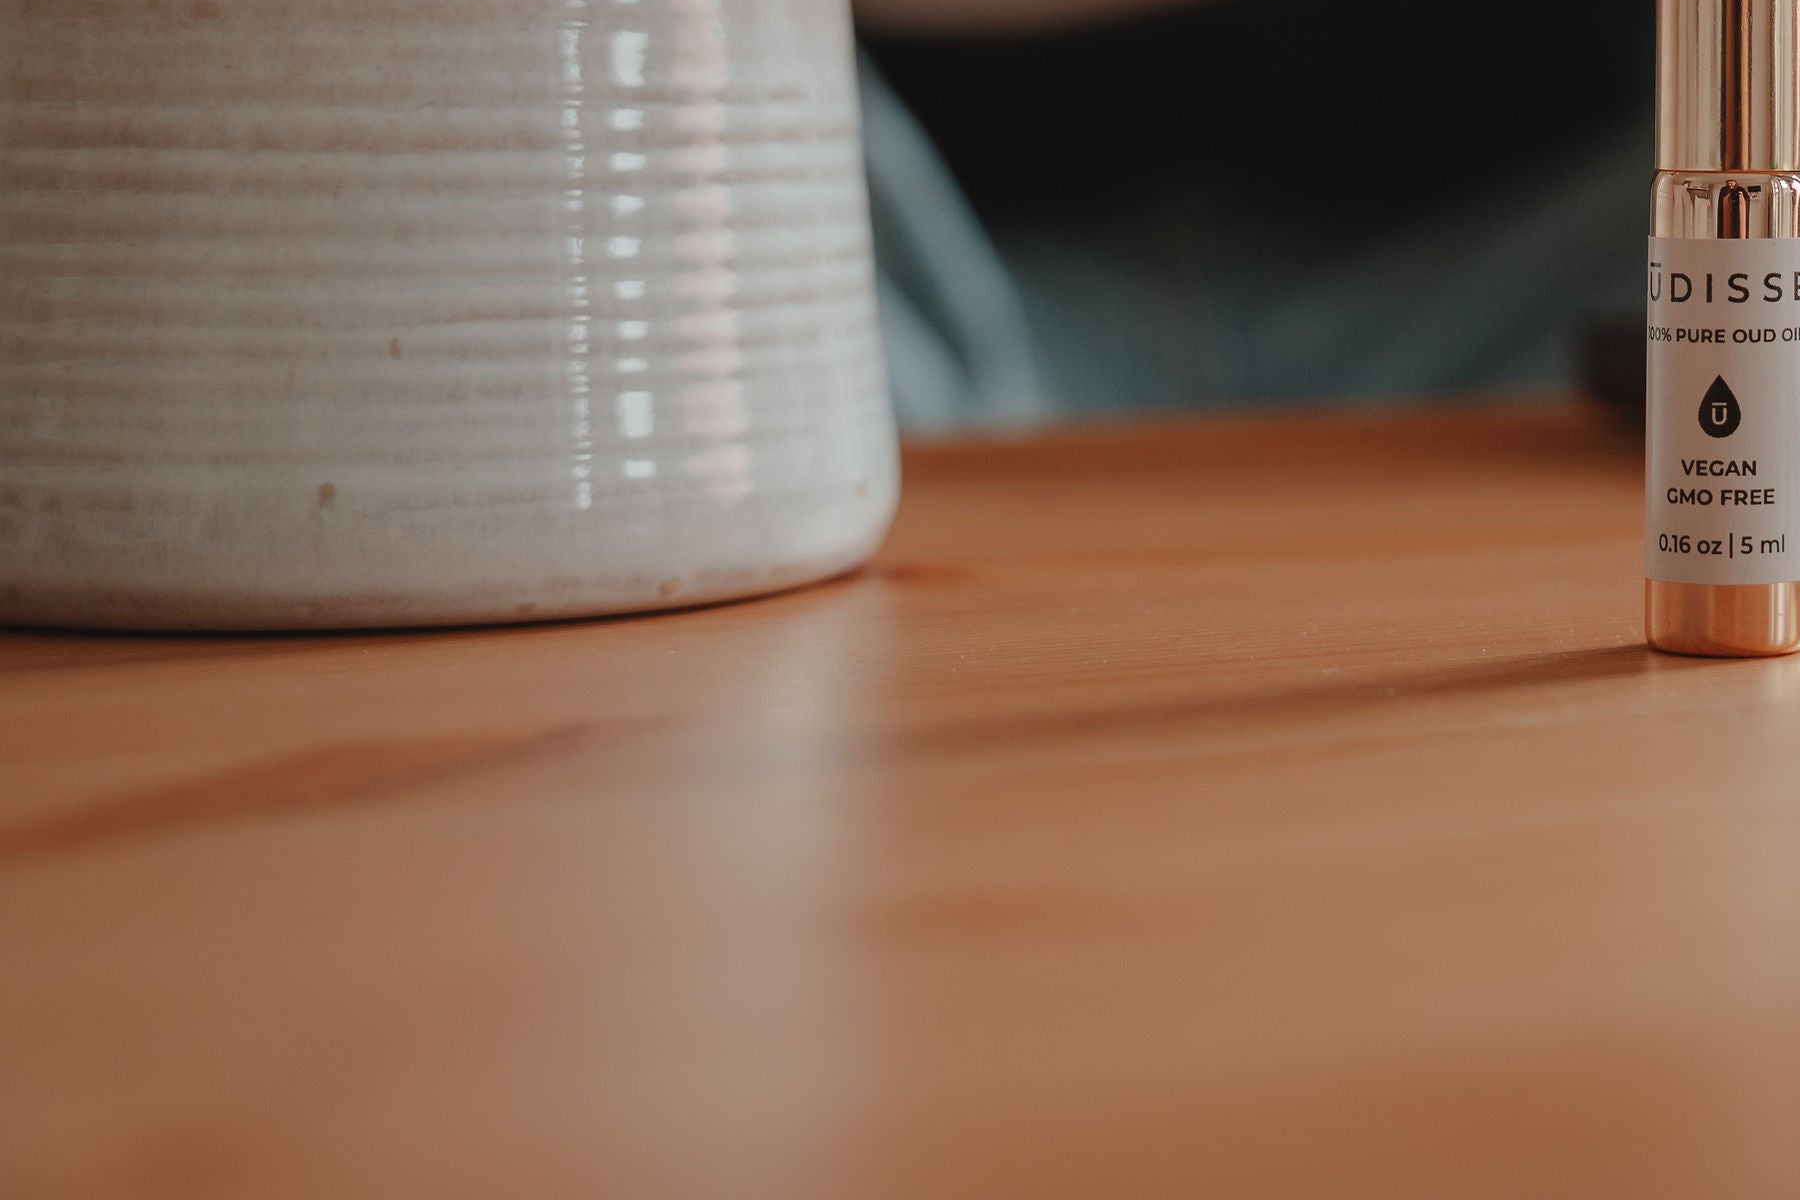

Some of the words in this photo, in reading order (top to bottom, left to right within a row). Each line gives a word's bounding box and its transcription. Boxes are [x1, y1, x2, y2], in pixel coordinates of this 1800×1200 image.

[1676, 328, 1726, 344] PURE
[1732, 328, 1777, 344] OUD
[1681, 459, 1757, 476] VEGAN
[1667, 487, 1713, 506] GMO
[1720, 488, 1776, 506] FREE
[1658, 533, 1691, 553] 0.16
[1697, 539, 1723, 554] oz
[1740, 536, 1753, 554] 5
[1760, 534, 1785, 554] ml
